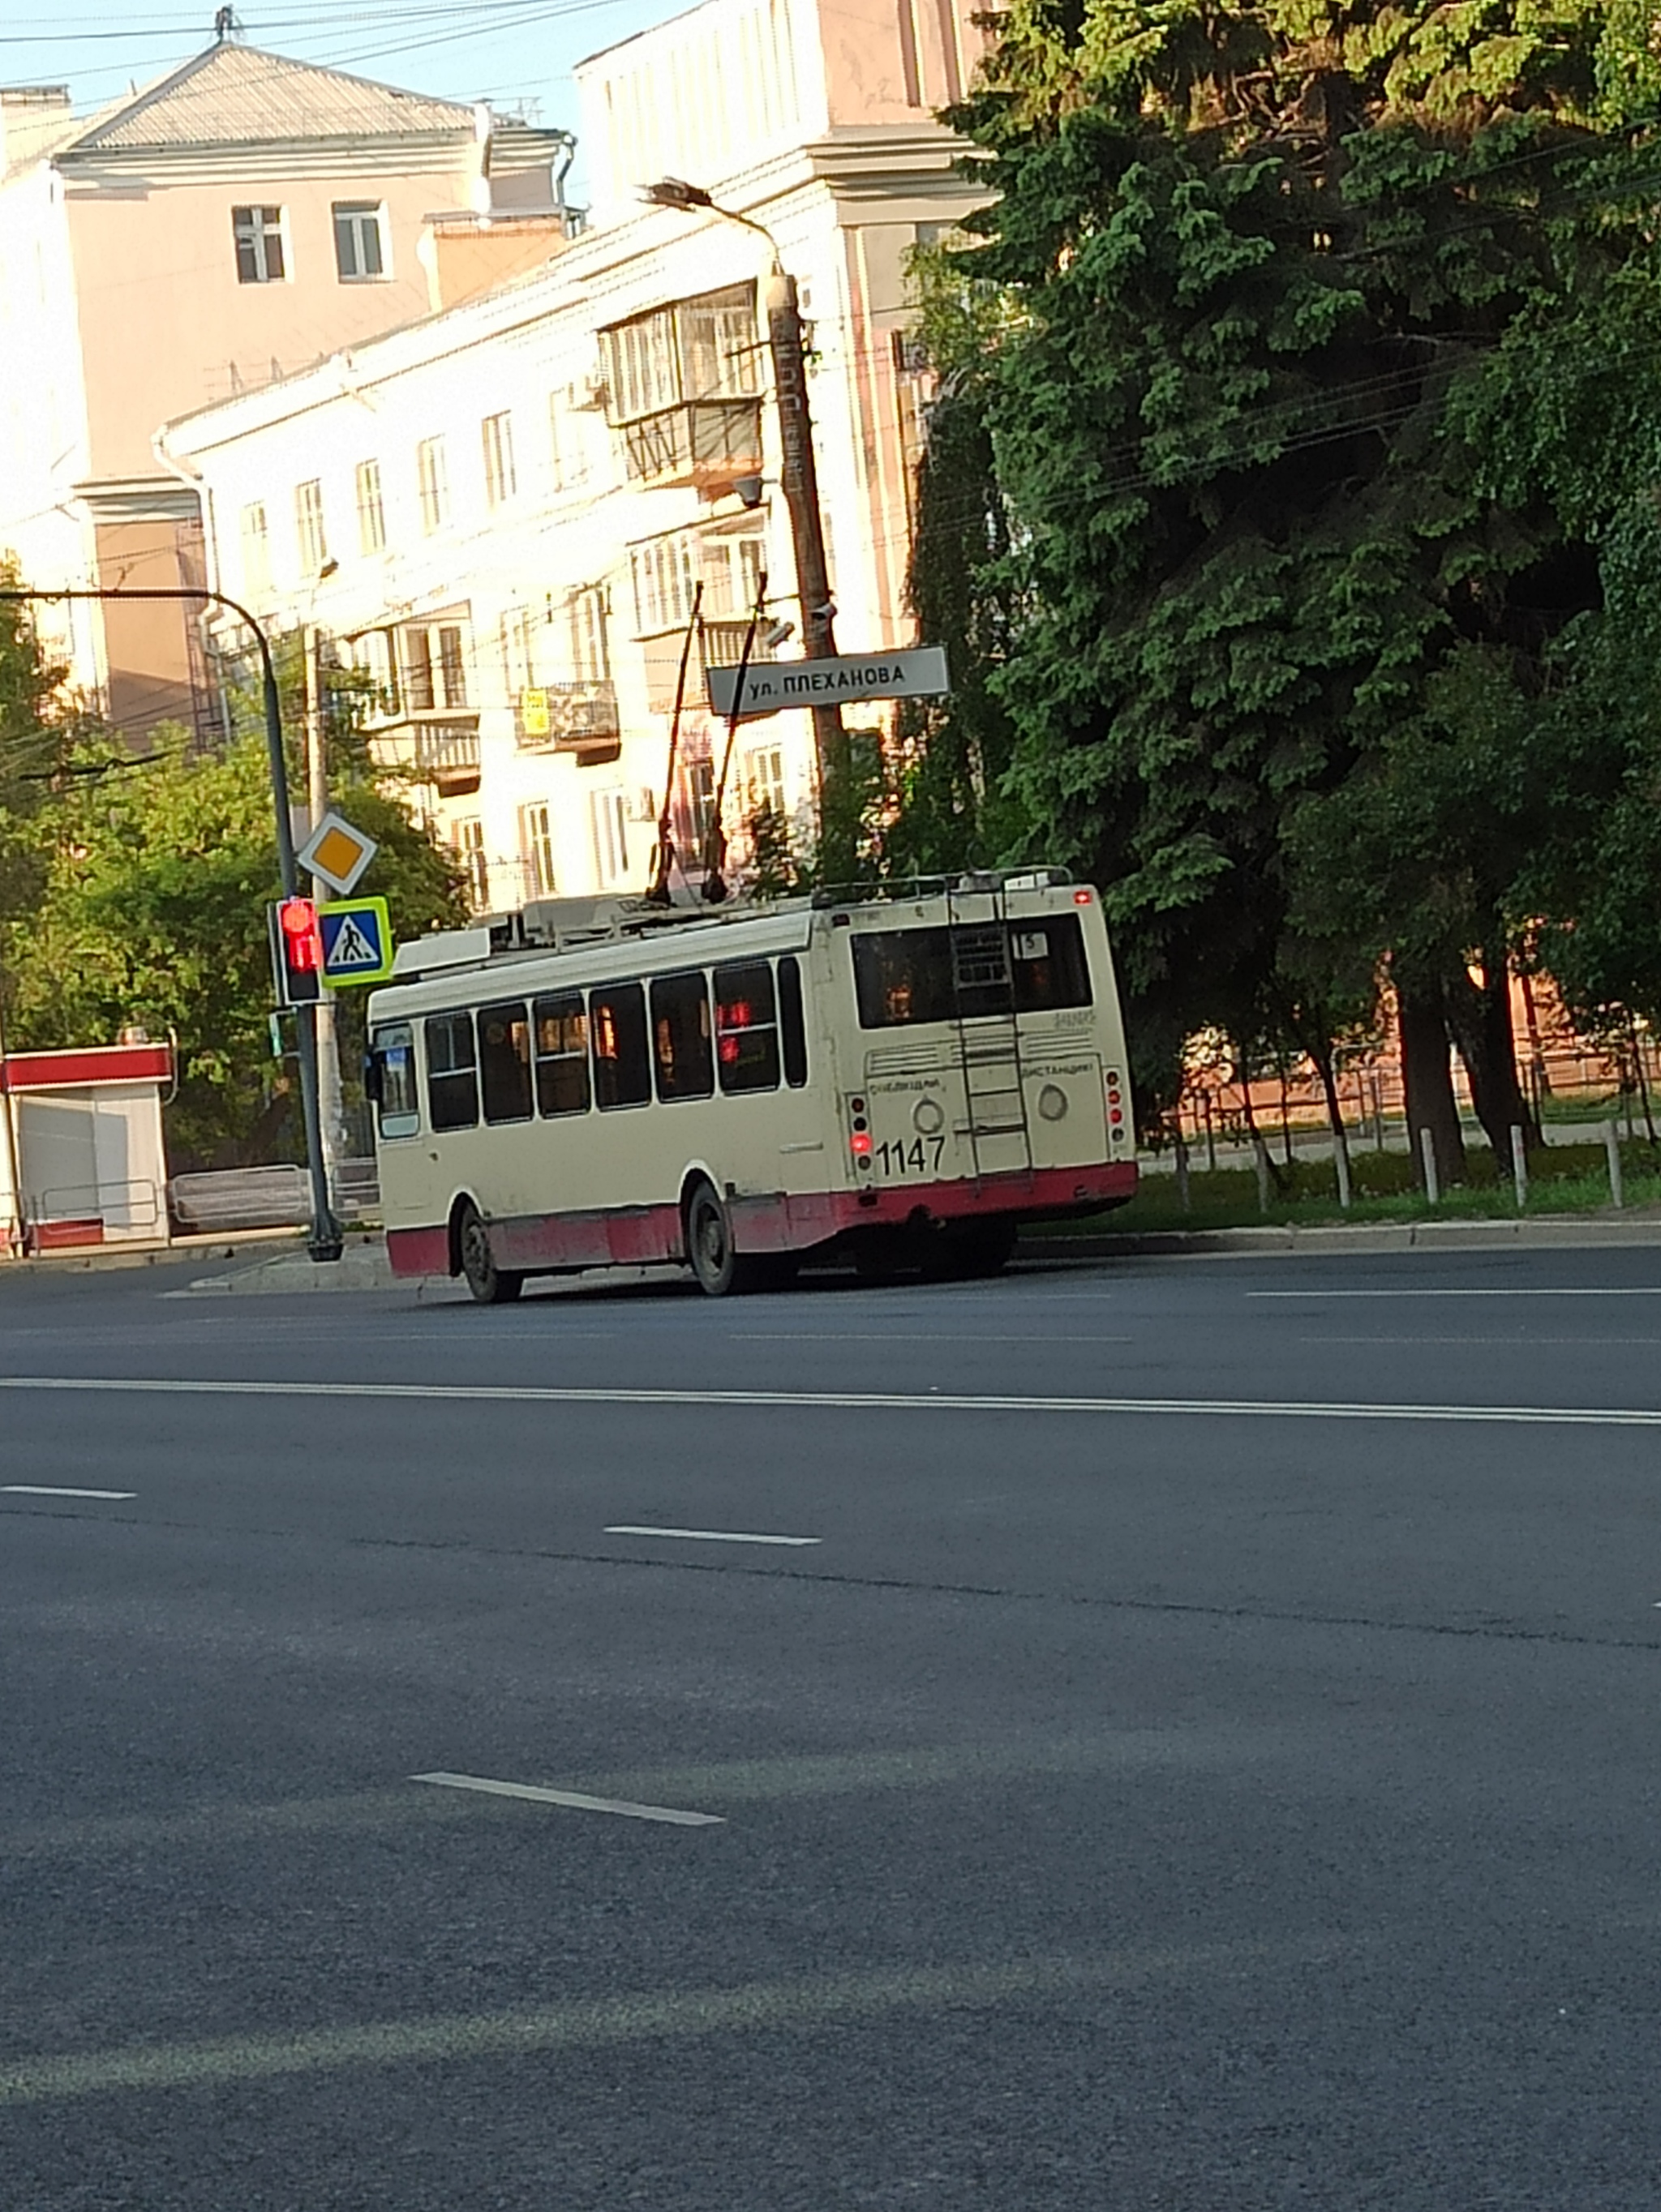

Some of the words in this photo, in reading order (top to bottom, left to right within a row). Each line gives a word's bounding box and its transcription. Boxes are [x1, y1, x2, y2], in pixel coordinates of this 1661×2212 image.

[749, 682, 778, 700] ул.
[783, 666, 905, 693] ПЛЕХАНОВА
[876, 1135, 945, 1176] 1147
